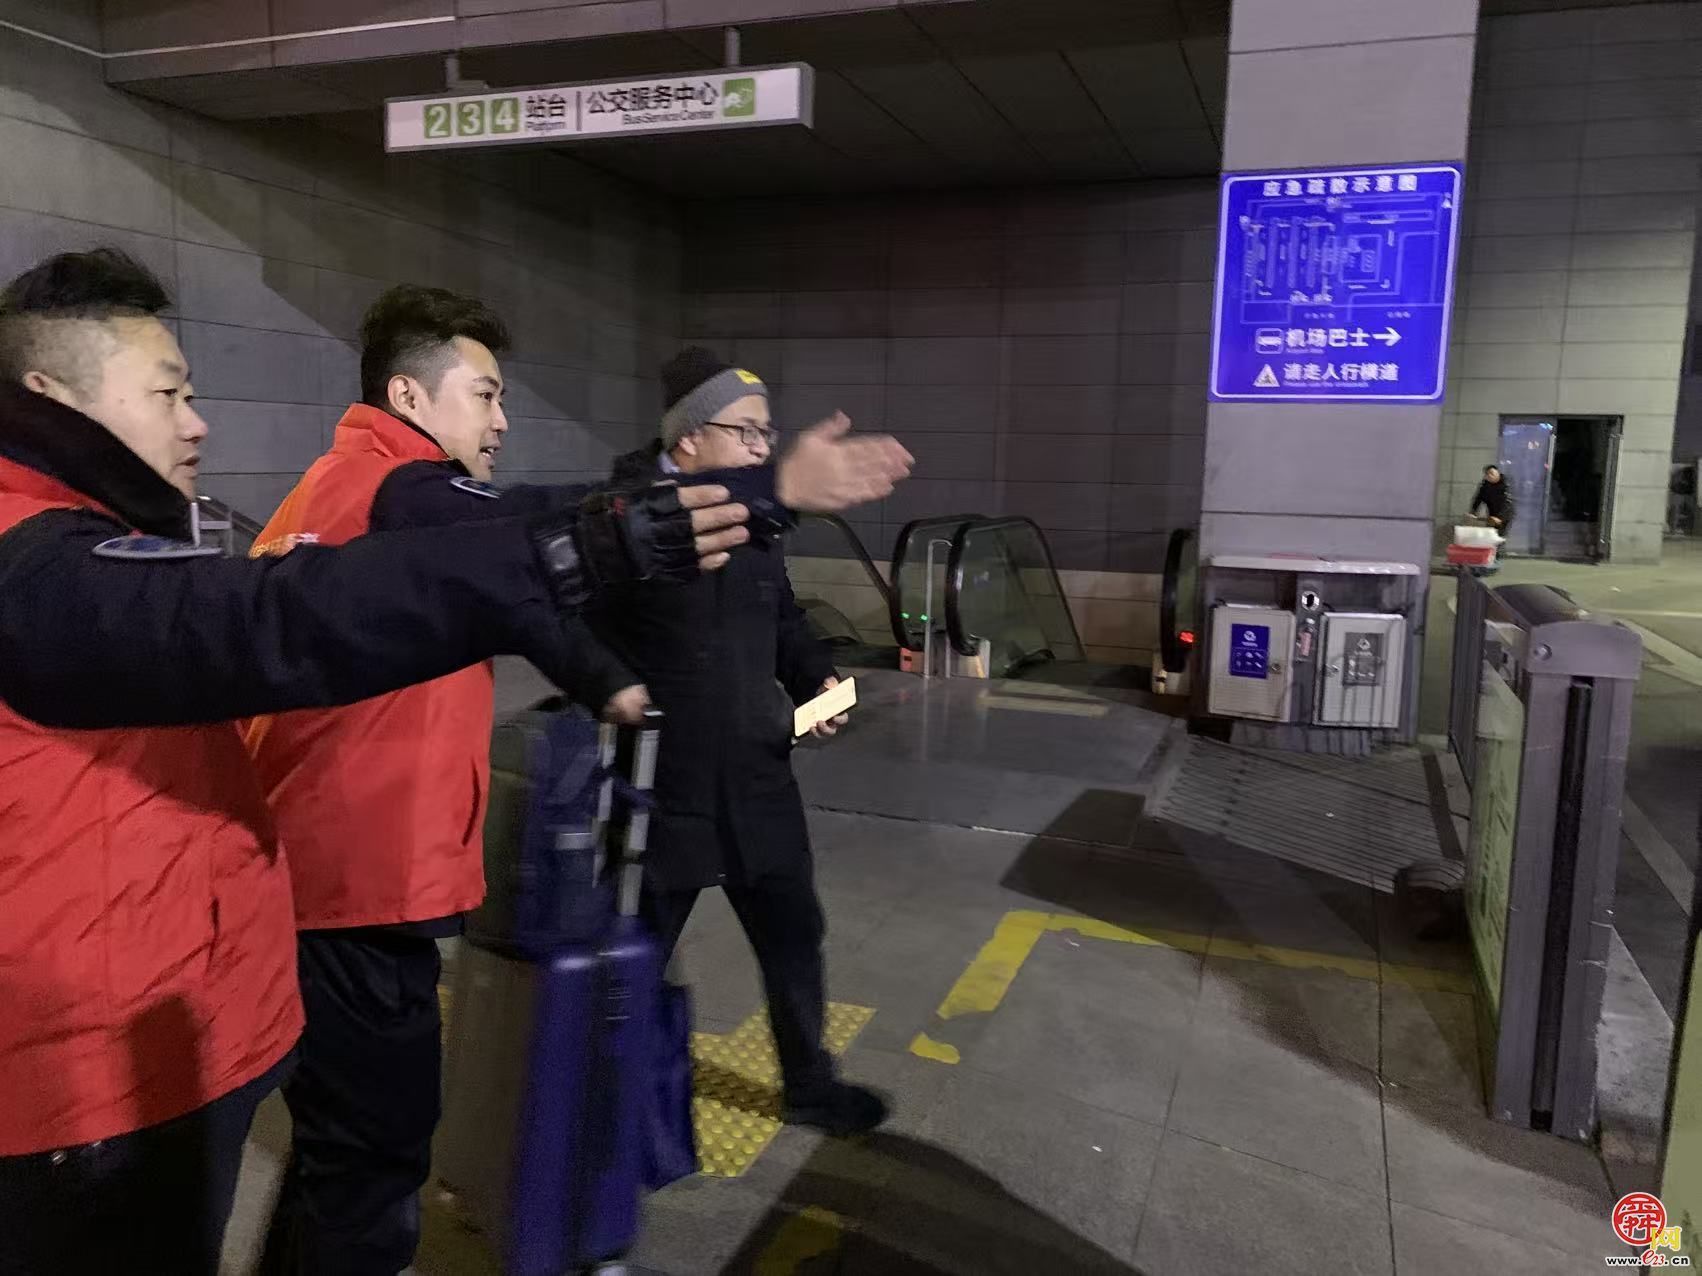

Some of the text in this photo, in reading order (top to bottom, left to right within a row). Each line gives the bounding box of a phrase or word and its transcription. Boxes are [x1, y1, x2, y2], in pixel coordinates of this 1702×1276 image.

[428, 82, 719, 137] 2 3 4 站台 公交服务中心
[1285, 327, 1371, 347] 机场巴士
[1283, 363, 1400, 381] 请走人行横道
